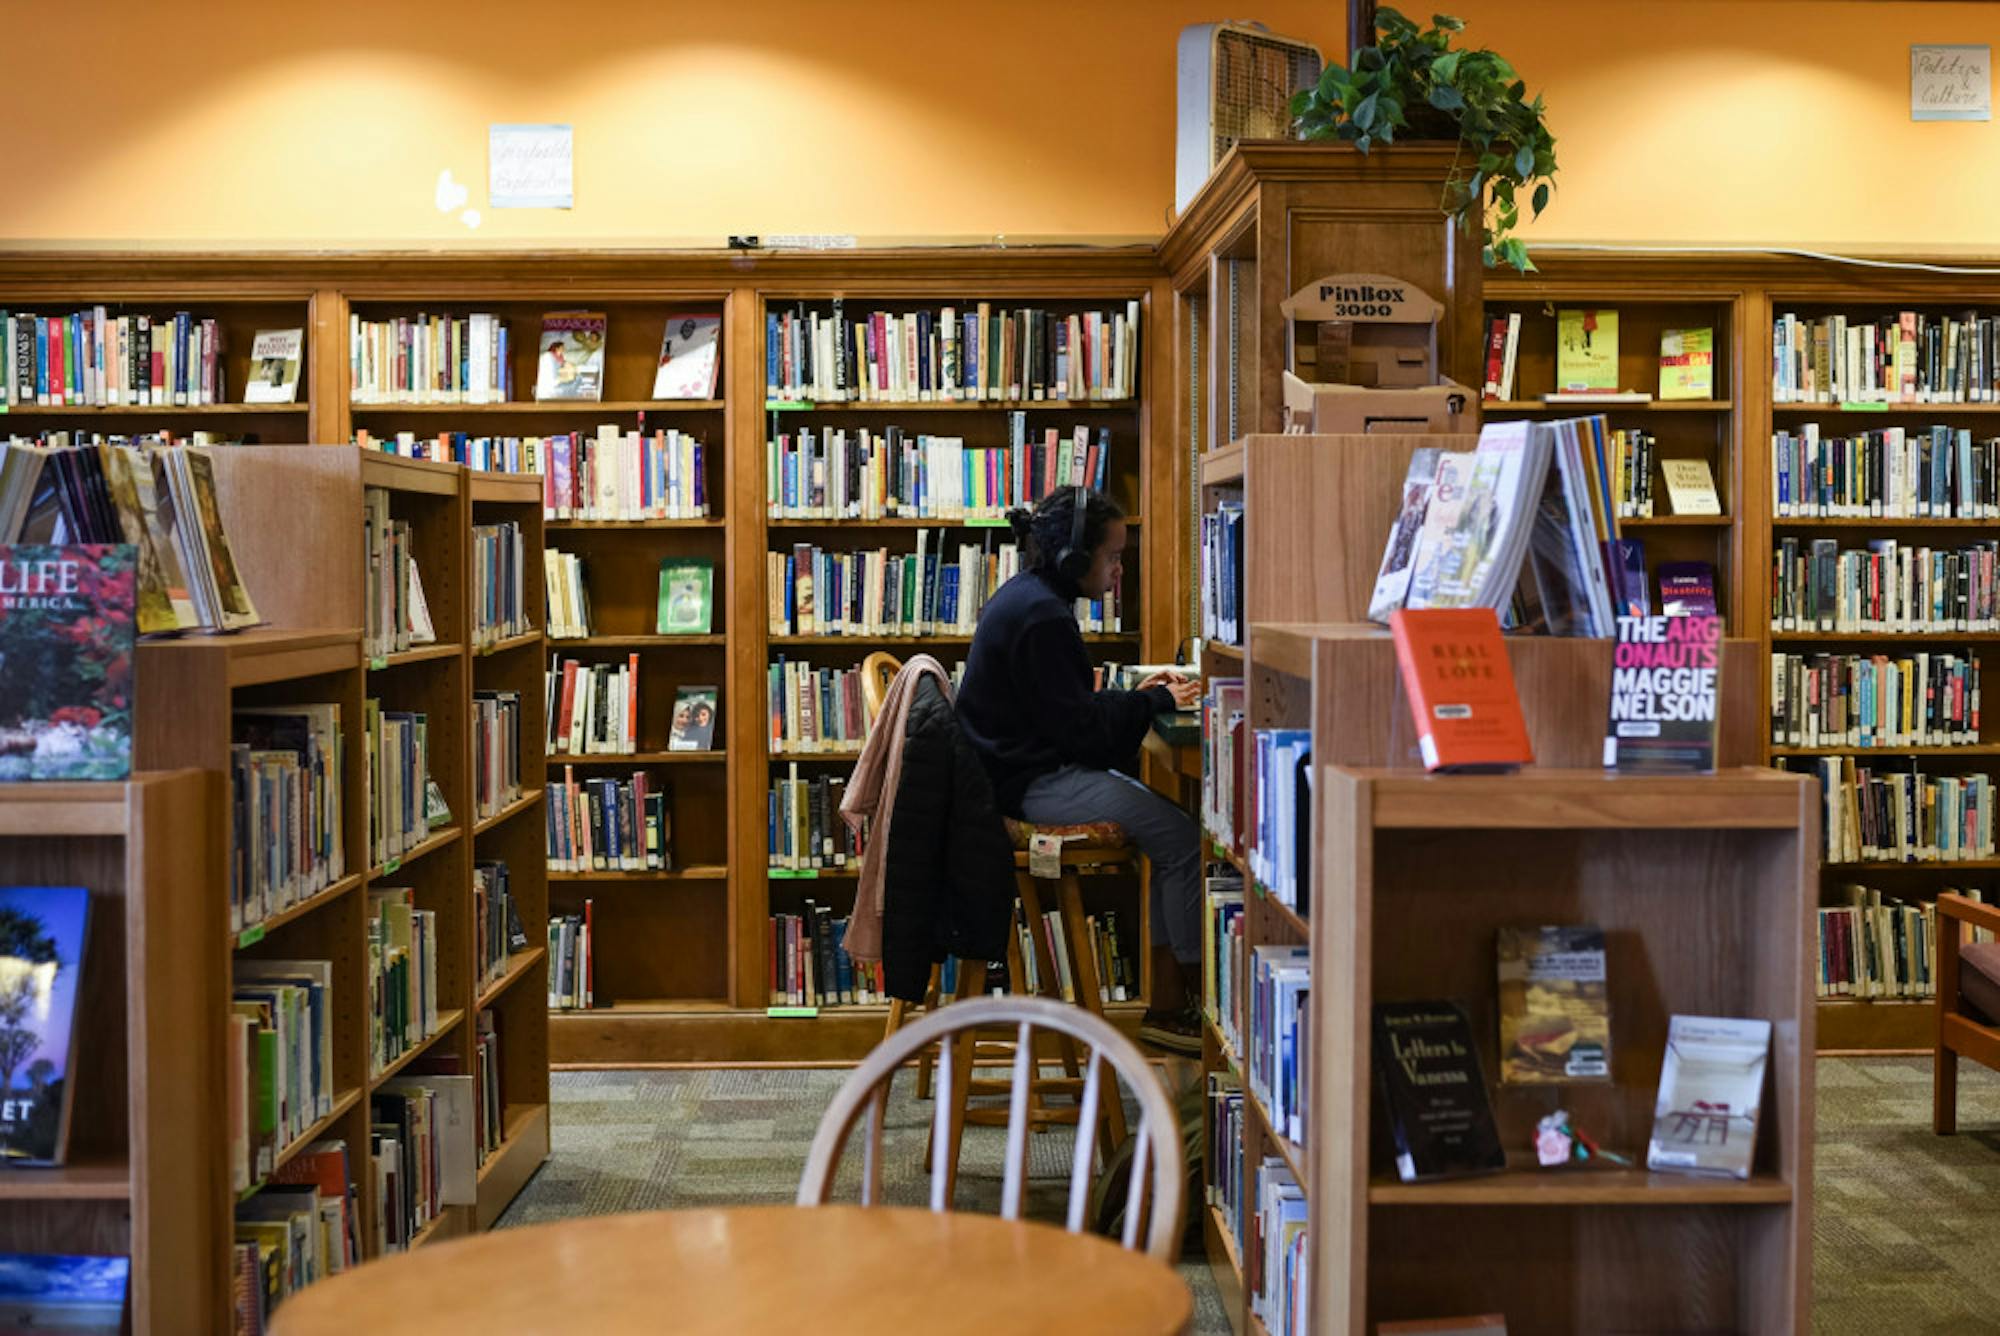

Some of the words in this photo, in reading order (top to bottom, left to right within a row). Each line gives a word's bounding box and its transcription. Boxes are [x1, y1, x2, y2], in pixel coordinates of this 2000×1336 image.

[1319, 286, 1405, 303] PinBox
[1334, 304, 1392, 317] 3000
[0, 560, 80, 593] LIFE
[2, 596, 74, 609] MERICA
[1616, 615, 1667, 643] THE
[1665, 616, 1720, 642] ARG
[1431, 643, 1490, 659] REAL
[1614, 642, 1719, 668] ONAUTS
[1437, 664, 1495, 679] LOVE
[1612, 667, 1718, 694] MAGGIE
[1610, 693, 1716, 721] NELSON
[1390, 1032, 1451, 1059] Letters
[1400, 1058, 1469, 1085] Vanessa
